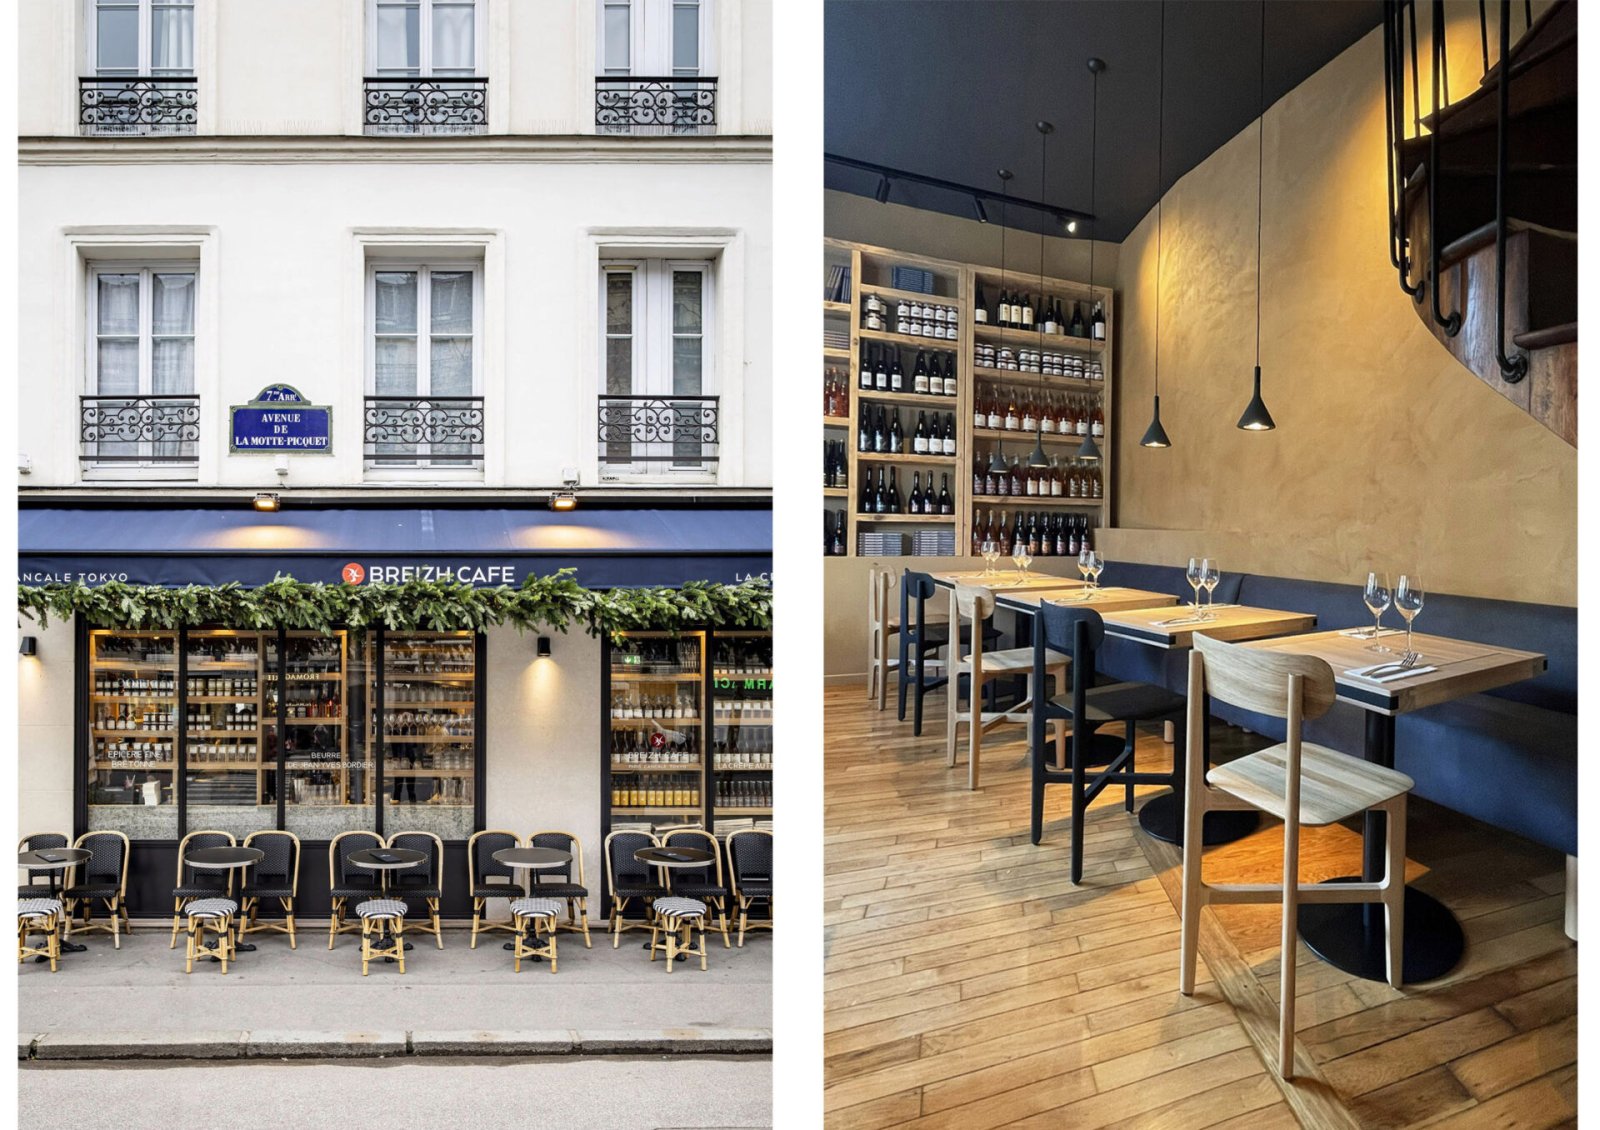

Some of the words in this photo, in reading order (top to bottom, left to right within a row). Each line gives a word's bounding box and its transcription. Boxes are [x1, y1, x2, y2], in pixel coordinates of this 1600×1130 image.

[261, 413, 301, 423] AVENUE
[273, 424, 288, 434] DE
[235, 436, 249, 446] LA
[250, 436, 328, 448] MOTTE-PICQUET
[78, 572, 128, 582] TOKYO
[369, 566, 451, 583] BREIZH
[457, 566, 515, 583] CAFE
[735, 572, 753, 582] LA
[760, 572, 773, 582] C
[310, 751, 341, 759] BEURRE
[111, 760, 156, 769] BRETONNE
